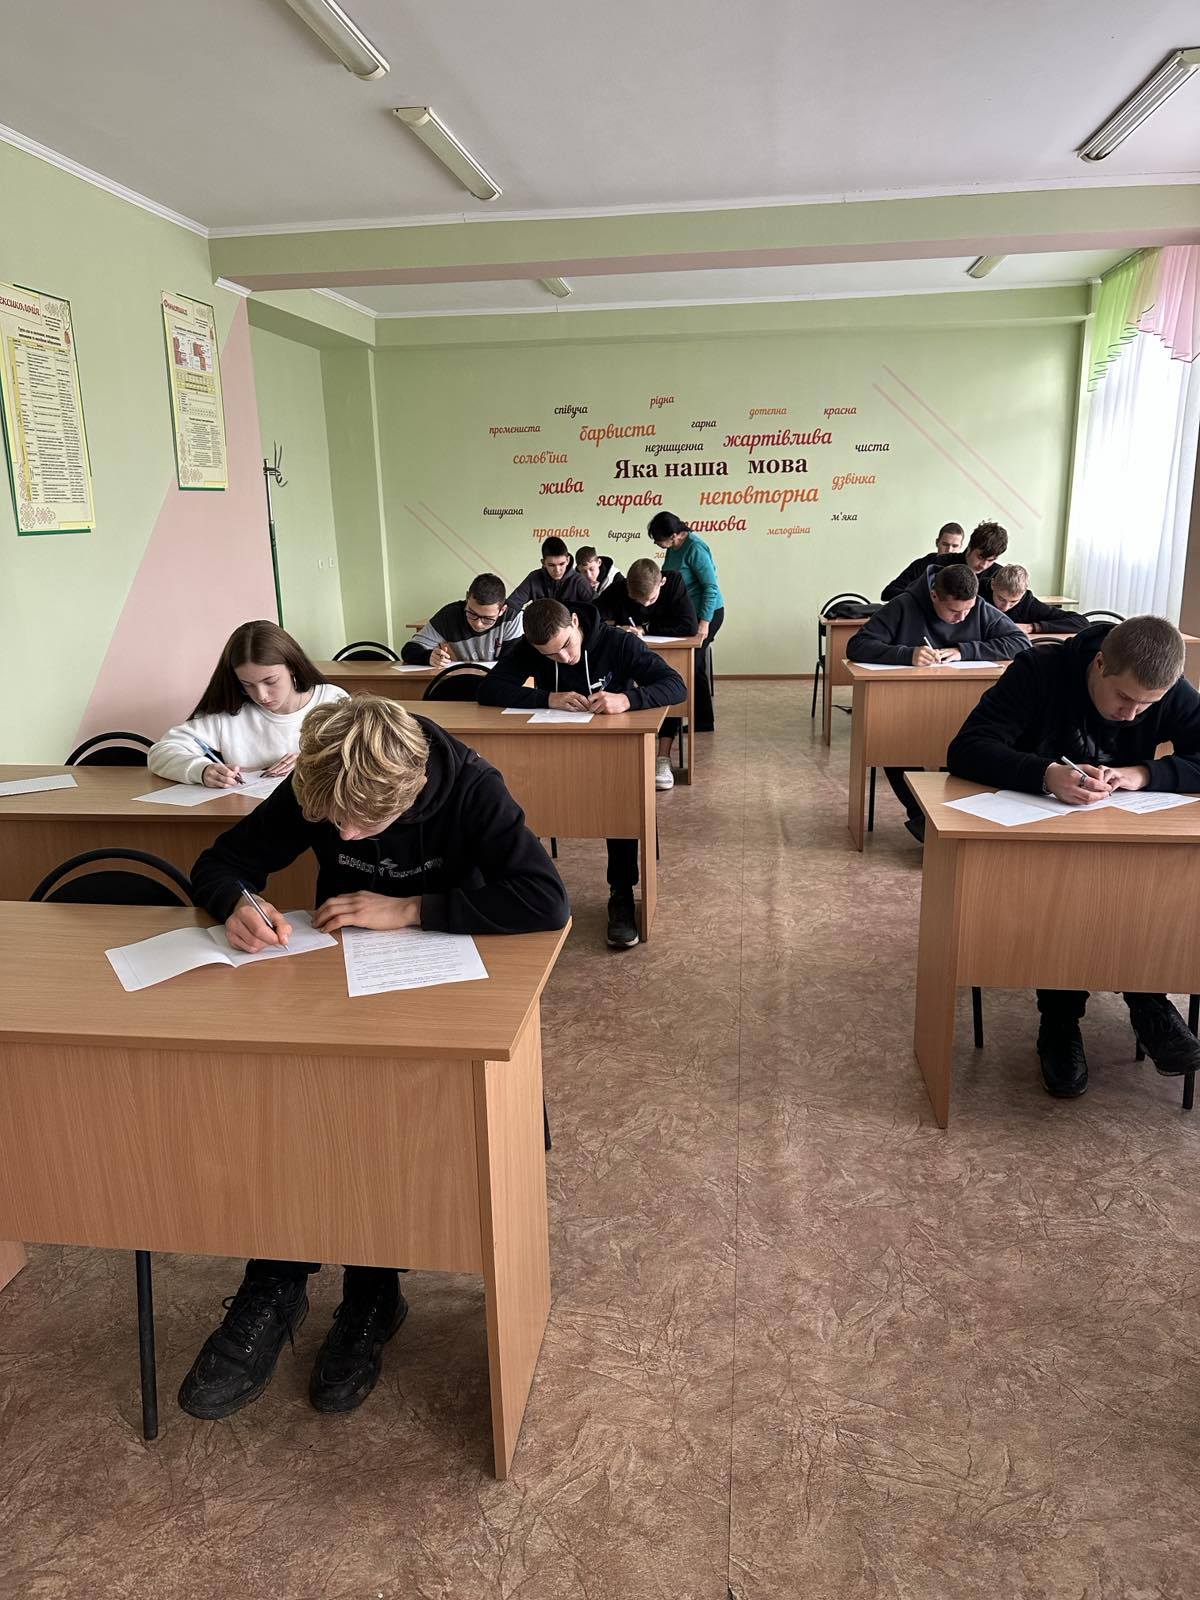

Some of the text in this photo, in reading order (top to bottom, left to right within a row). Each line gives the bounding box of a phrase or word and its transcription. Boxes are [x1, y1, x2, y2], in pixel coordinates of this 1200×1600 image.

[0, 296, 40, 316] ексикологія
[650, 396, 674, 409] рідна
[555, 405, 588, 418] співуча
[749, 408, 787, 419] дотепна
[824, 408, 856, 419] красна
[489, 426, 540, 437] промениста
[691, 421, 716, 431] гарна
[580, 424, 656, 447] барвиста
[723, 429, 832, 454] жартівлива
[645, 444, 703, 456] незнищенна
[855, 443, 890, 453] чиста
[614, 458, 809, 478] Яка наша мова
[539, 478, 584, 494] жива
[832, 473, 875, 490] дзвінка
[597, 491, 663, 513] яскрава
[700, 486, 818, 512] неповторна
[483, 507, 523, 519] вишукана
[830, 511, 858, 521] м'яка
[686, 516, 747, 532] анкова
[608, 530, 640, 542] виразна
[767, 526, 810, 538] мелодійна
